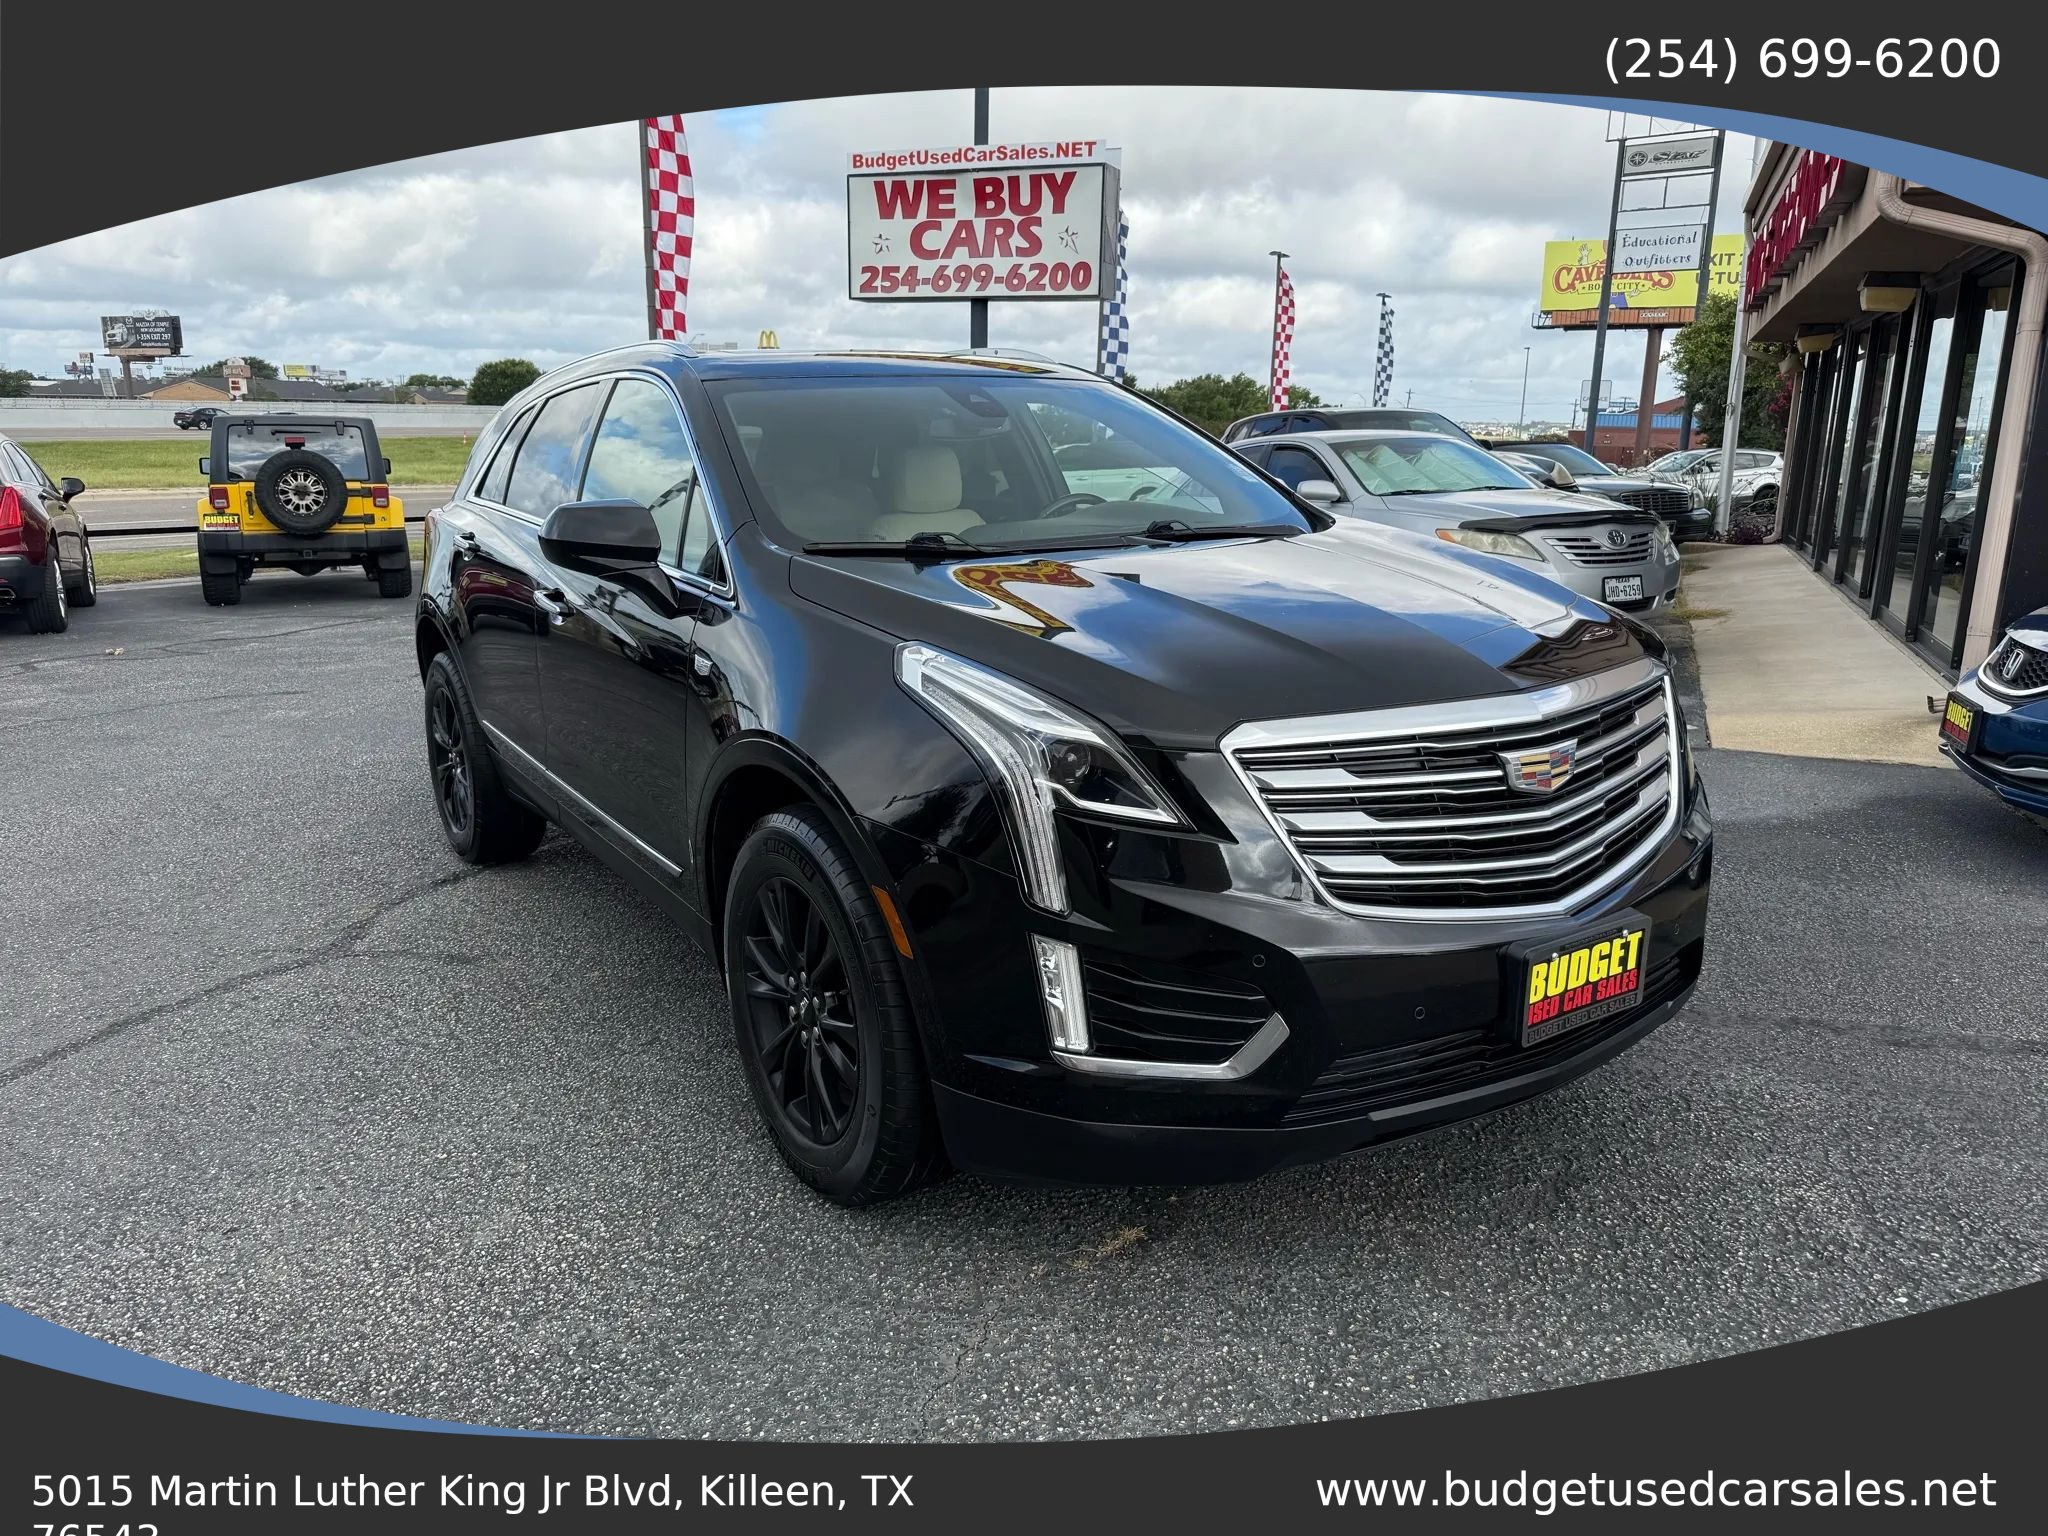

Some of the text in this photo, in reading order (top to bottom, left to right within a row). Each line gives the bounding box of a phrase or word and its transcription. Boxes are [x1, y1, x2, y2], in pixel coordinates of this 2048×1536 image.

[852, 141, 1097, 169] BudgetUsedCarSales.NET
[873, 171, 1077, 220] WE BUY
[909, 216, 1042, 260] CARS
[1622, 231, 1697, 248] Educational
[1624, 253, 1692, 268] Outfitters
[1709, 253, 1736, 266] XIT
[859, 262, 1092, 294] 254-699-6200
[1616, 282, 1640, 291] CITY
[204, 515, 239, 523] BUDGET
[1529, 930, 1643, 1004] BUDGET
[1564, 984, 1593, 1011] CAR
[1596, 968, 1638, 1001] SALES
[1528, 995, 1636, 1043] BUDGET USED CAR SALES
